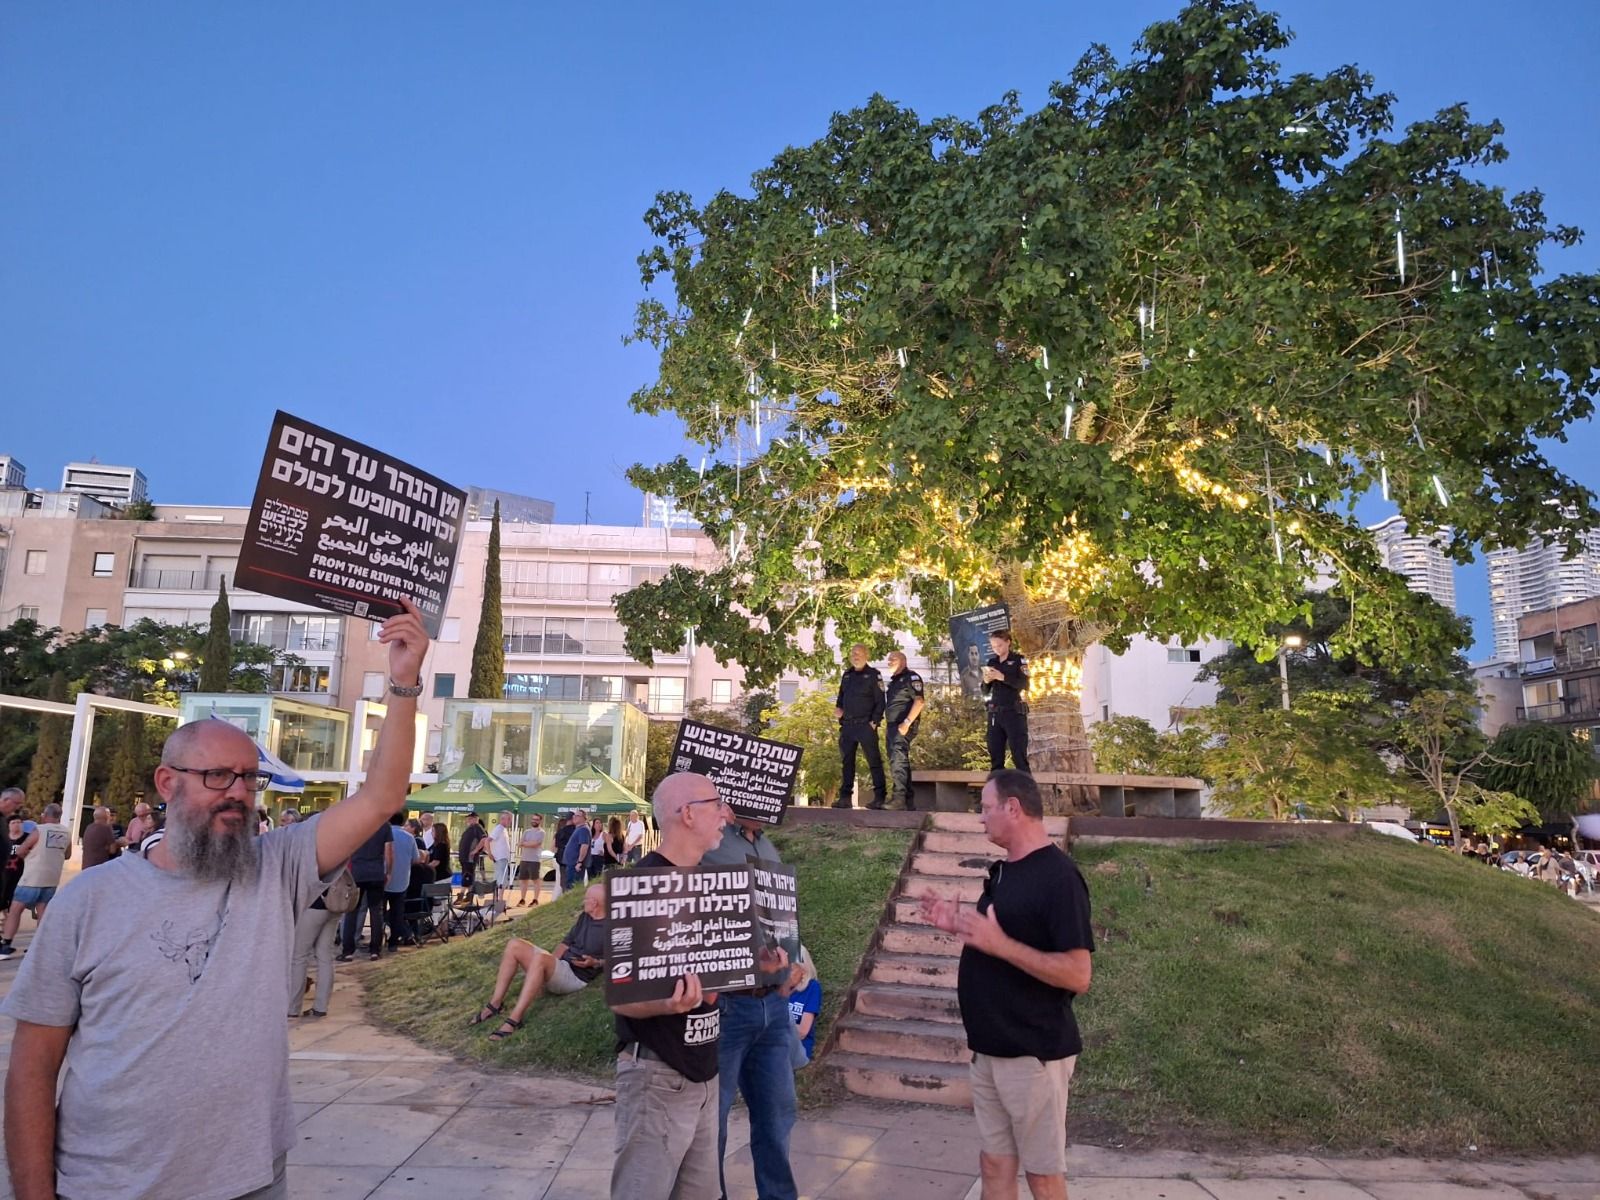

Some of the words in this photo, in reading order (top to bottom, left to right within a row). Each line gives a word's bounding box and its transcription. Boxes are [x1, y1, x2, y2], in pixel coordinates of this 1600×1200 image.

[279, 425, 335, 467] הים
[341, 448, 378, 482] עד
[272, 458, 346, 499] לכולם
[384, 464, 438, 508] הנהר
[264, 498, 309, 520] מסתכלים
[348, 485, 411, 524] וחופש
[440, 491, 460, 519] מן
[261, 509, 307, 530] לכיבוש
[322, 515, 369, 536] البحر
[412, 509, 456, 543] זכויות
[259, 519, 303, 543] בעיניים
[370, 530, 402, 546] حتى
[318, 533, 369, 556] للجميع
[402, 541, 433, 559] النهر
[369, 547, 419, 577] والحقوق
[434, 551, 450, 567] من
[312, 554, 346, 572] FROM
[347, 563, 369, 578] THE
[370, 569, 401, 588] RIVER
[403, 578, 414, 591] TO
[415, 583, 429, 597] THE
[420, 562, 447, 584] الحرية
[308, 567, 381, 595] EVERYBODY
[422, 600, 440, 614] FREE
[684, 724, 743, 750] לכיבוש
[680, 740, 750, 766] דיקטטורה
[745, 740, 798, 763] שתקנו
[751, 757, 794, 778] קיבלנו
[716, 786, 732, 795] THE
[731, 789, 783, 807] OCCUPATION,
[747, 782, 763, 792] على
[720, 794, 781, 813] ICTATORSHIP
[611, 871, 684, 897] לכיבוש
[688, 871, 749, 895] שתקנו
[772, 873, 796, 892] טיהור
[611, 898, 696, 920] דיקטטורה
[700, 893, 751, 913] קיבלנו
[778, 894, 797, 912] פשע
[667, 919, 702, 936] الاحتلال
[703, 916, 723, 934] أمام
[723, 917, 752, 929] صمتنا
[704, 931, 722, 947] على
[723, 930, 752, 942] حصلنا
[638, 954, 667, 968] FIRST
[668, 953, 687, 964] THE
[688, 947, 753, 962] OCCUPATION,
[638, 966, 667, 981] NOW
[669, 958, 754, 977] DICTATORSHIP
